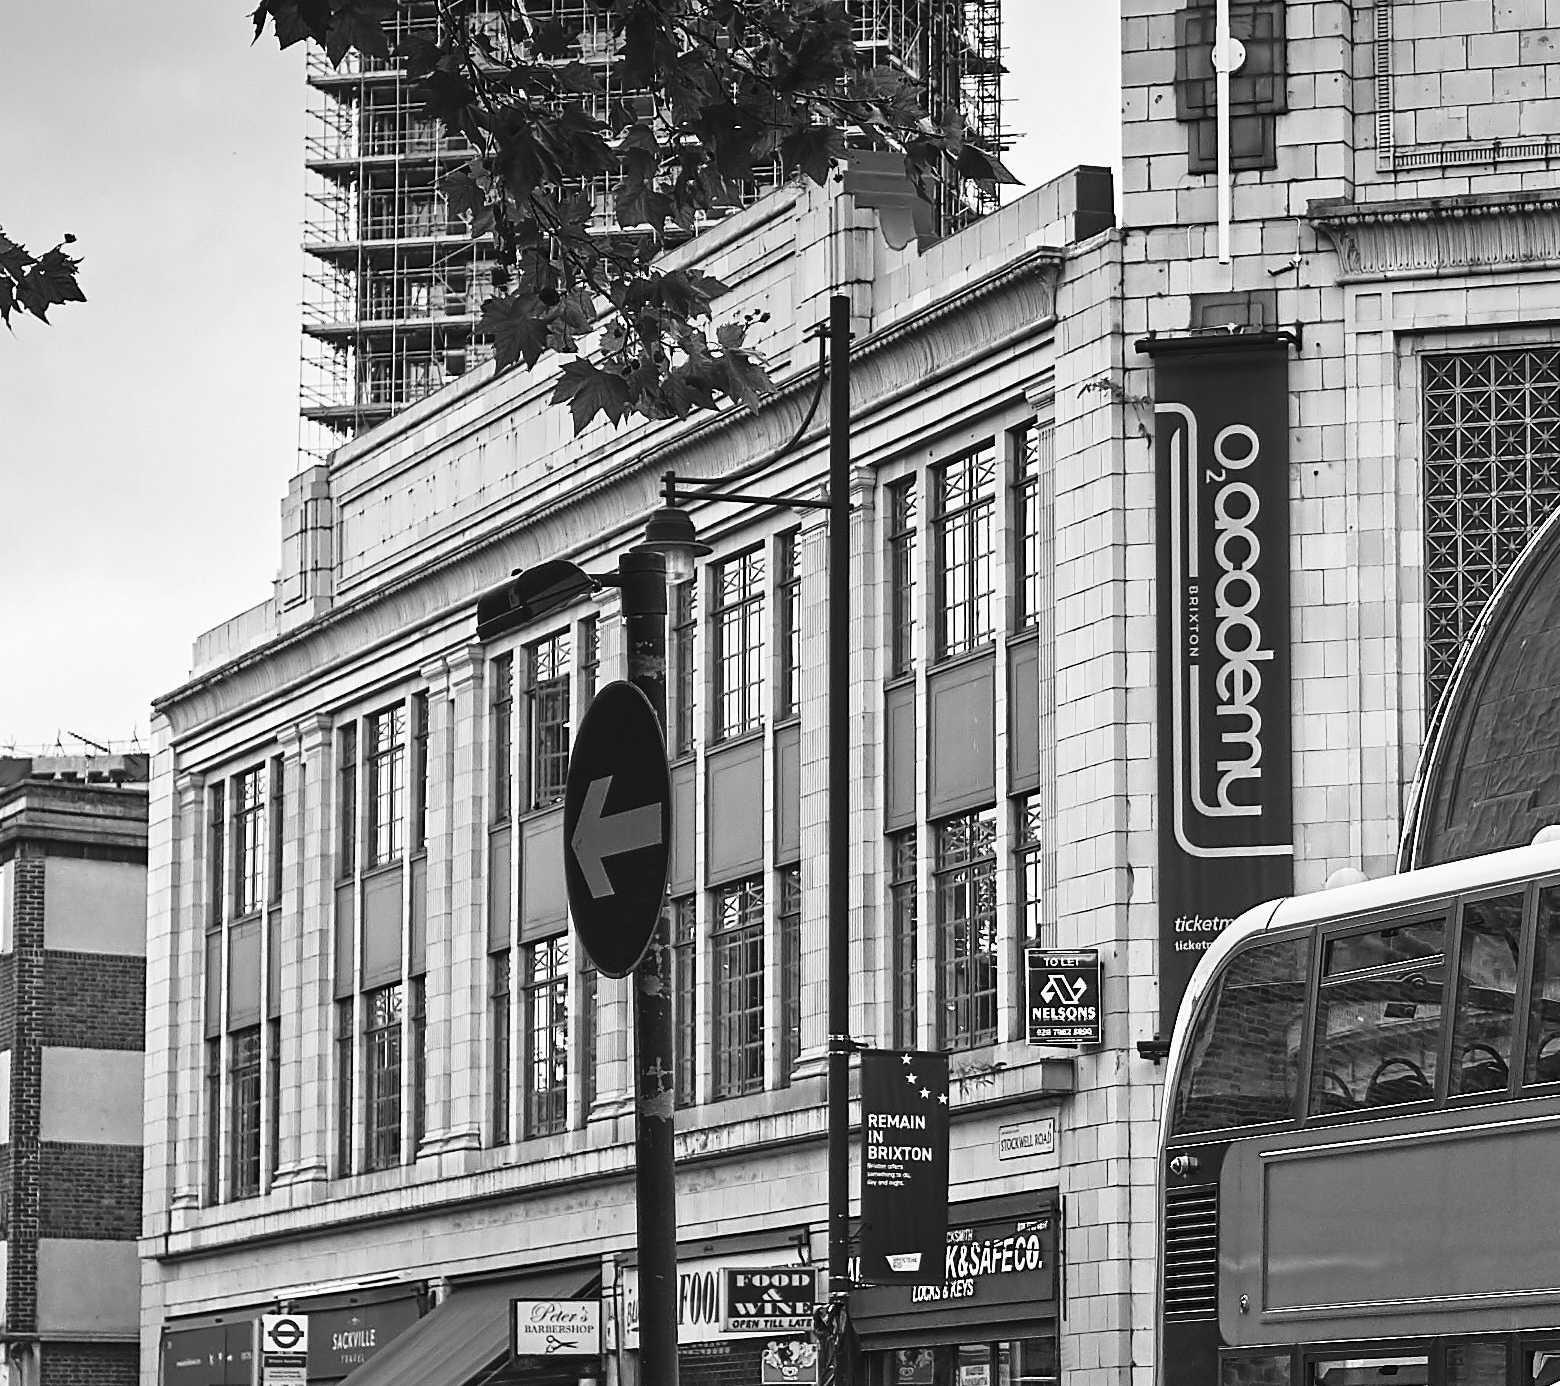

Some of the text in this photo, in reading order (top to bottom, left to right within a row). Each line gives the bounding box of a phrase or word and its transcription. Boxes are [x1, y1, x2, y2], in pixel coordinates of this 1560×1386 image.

[1188, 585, 1200, 658] BRIXTON
[1043, 956, 1079, 967] TO LET
[1032, 1006, 1096, 1022] NELSONS
[868, 1114, 926, 1130] REMAIN
[868, 1130, 884, 1144] IN
[1001, 1133, 1034, 1152] STOCKWELL
[1034, 1130, 1052, 1146] ROAD
[868, 1146, 933, 1162] BRIXTON
[736, 1274, 811, 1287] FOOD
[762, 1288, 783, 1301] &
[912, 1285, 941, 1303] LOCKS
[950, 1278, 974, 1298] KEYS
[530, 1303, 589, 1324] Peter's
[734, 1301, 812, 1316] WINE
[524, 1325, 595, 1334] BARBERSHOP
[732, 1318, 812, 1329] OPEN TILL LATE
[332, 1328, 376, 1351] SACKVILLE
